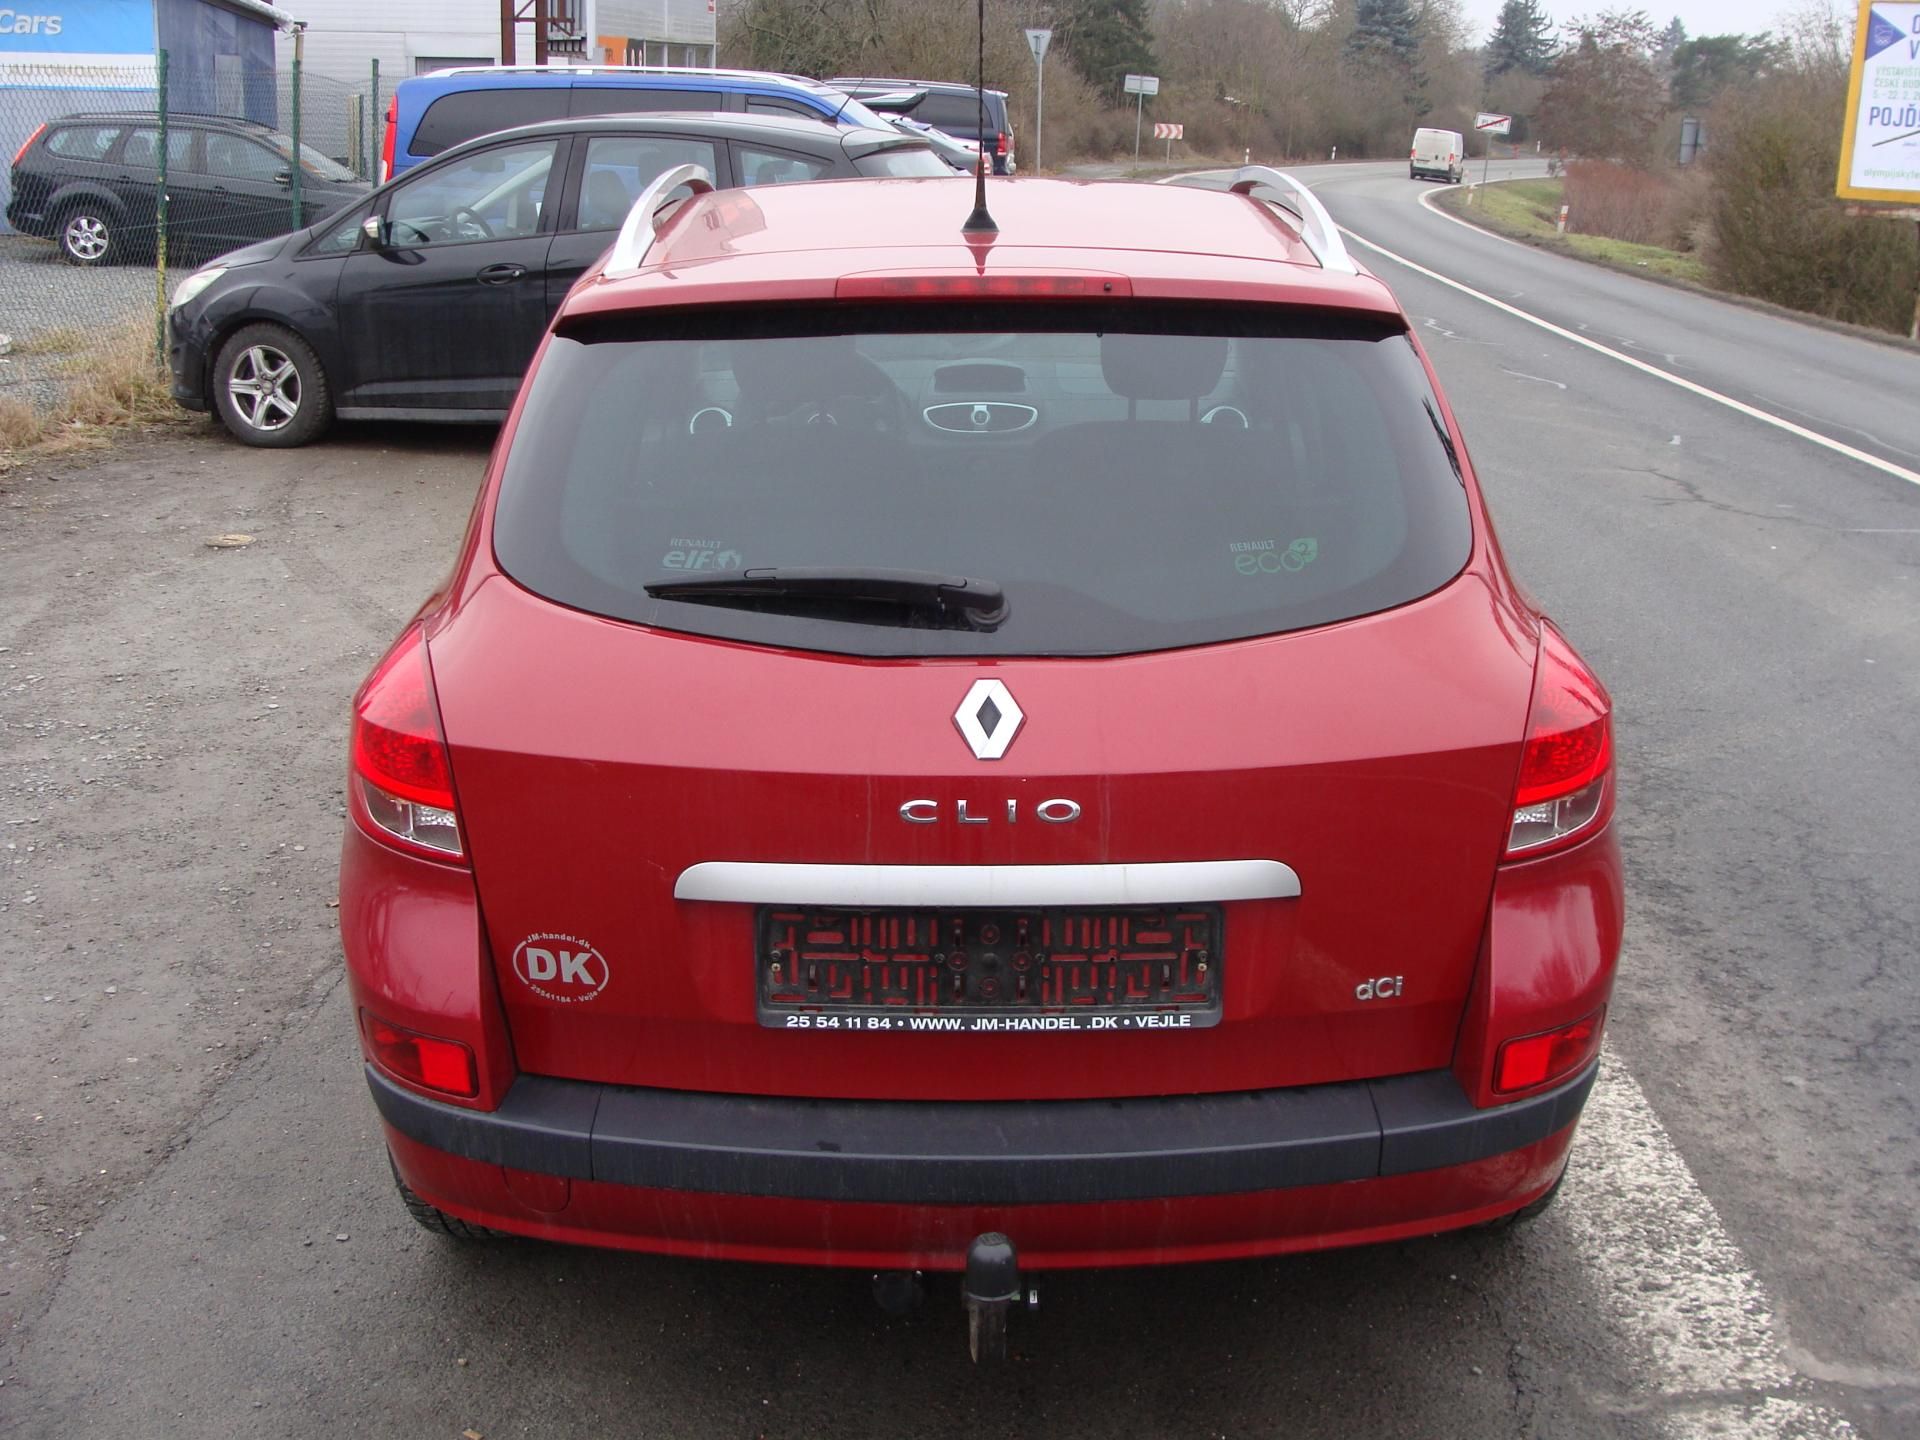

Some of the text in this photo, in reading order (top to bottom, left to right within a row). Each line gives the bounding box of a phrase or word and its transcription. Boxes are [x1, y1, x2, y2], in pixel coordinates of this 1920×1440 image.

[0, 9, 62, 35] Cars
[1230, 540, 1275, 552] RENAULT
[900, 799, 1081, 823] CLIO
[526, 947, 596, 985] DK
[1356, 975, 1403, 1000] dCi
[786, 1015, 811, 1028] 25
[816, 1016, 840, 1029] 54
[845, 1017, 861, 1029] 11
[867, 1017, 891, 1029] 84
[909, 1018, 965, 1030] WWW.
[971, 1017, 1081, 1030] JM-HANDEL
[1135, 1014, 1191, 1027] VEJLE
